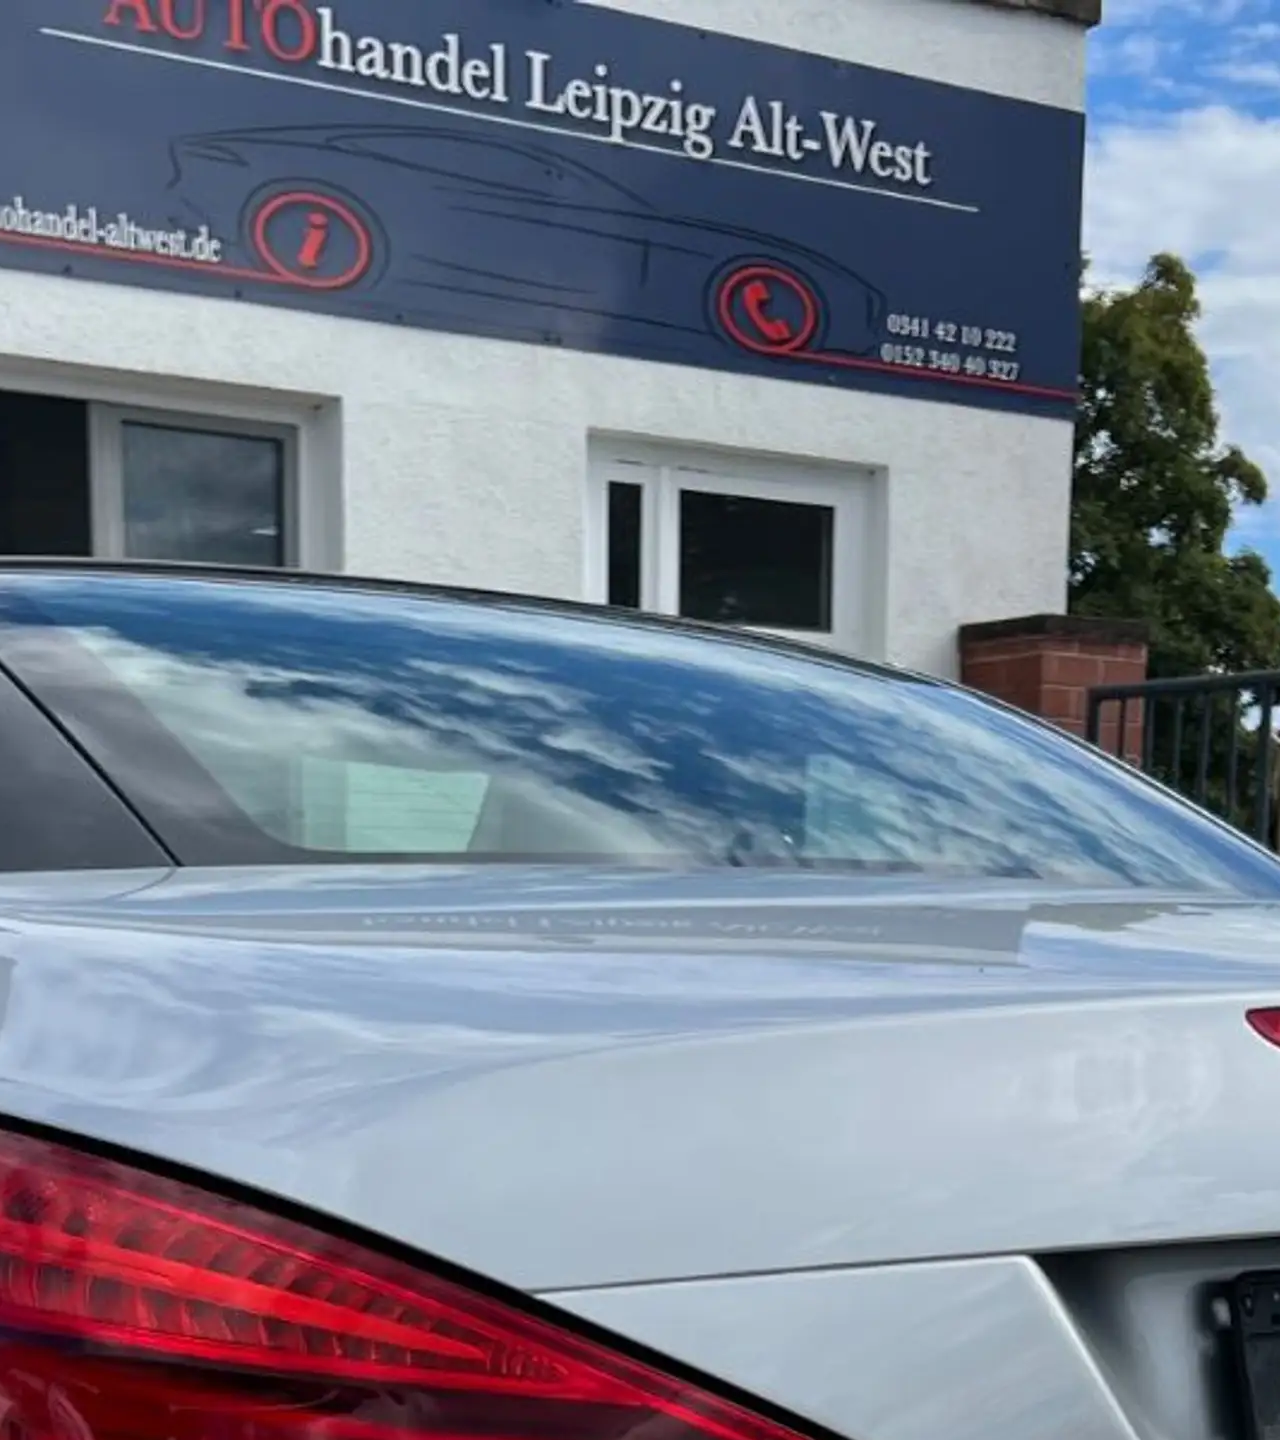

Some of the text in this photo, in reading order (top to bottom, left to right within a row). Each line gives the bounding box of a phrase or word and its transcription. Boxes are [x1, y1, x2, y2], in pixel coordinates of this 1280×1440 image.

[524, 50, 716, 160] Leipzig
[727, 95, 933, 184] Alt-West
[934, 320, 958, 343] 42
[984, 328, 1017, 353] 222
